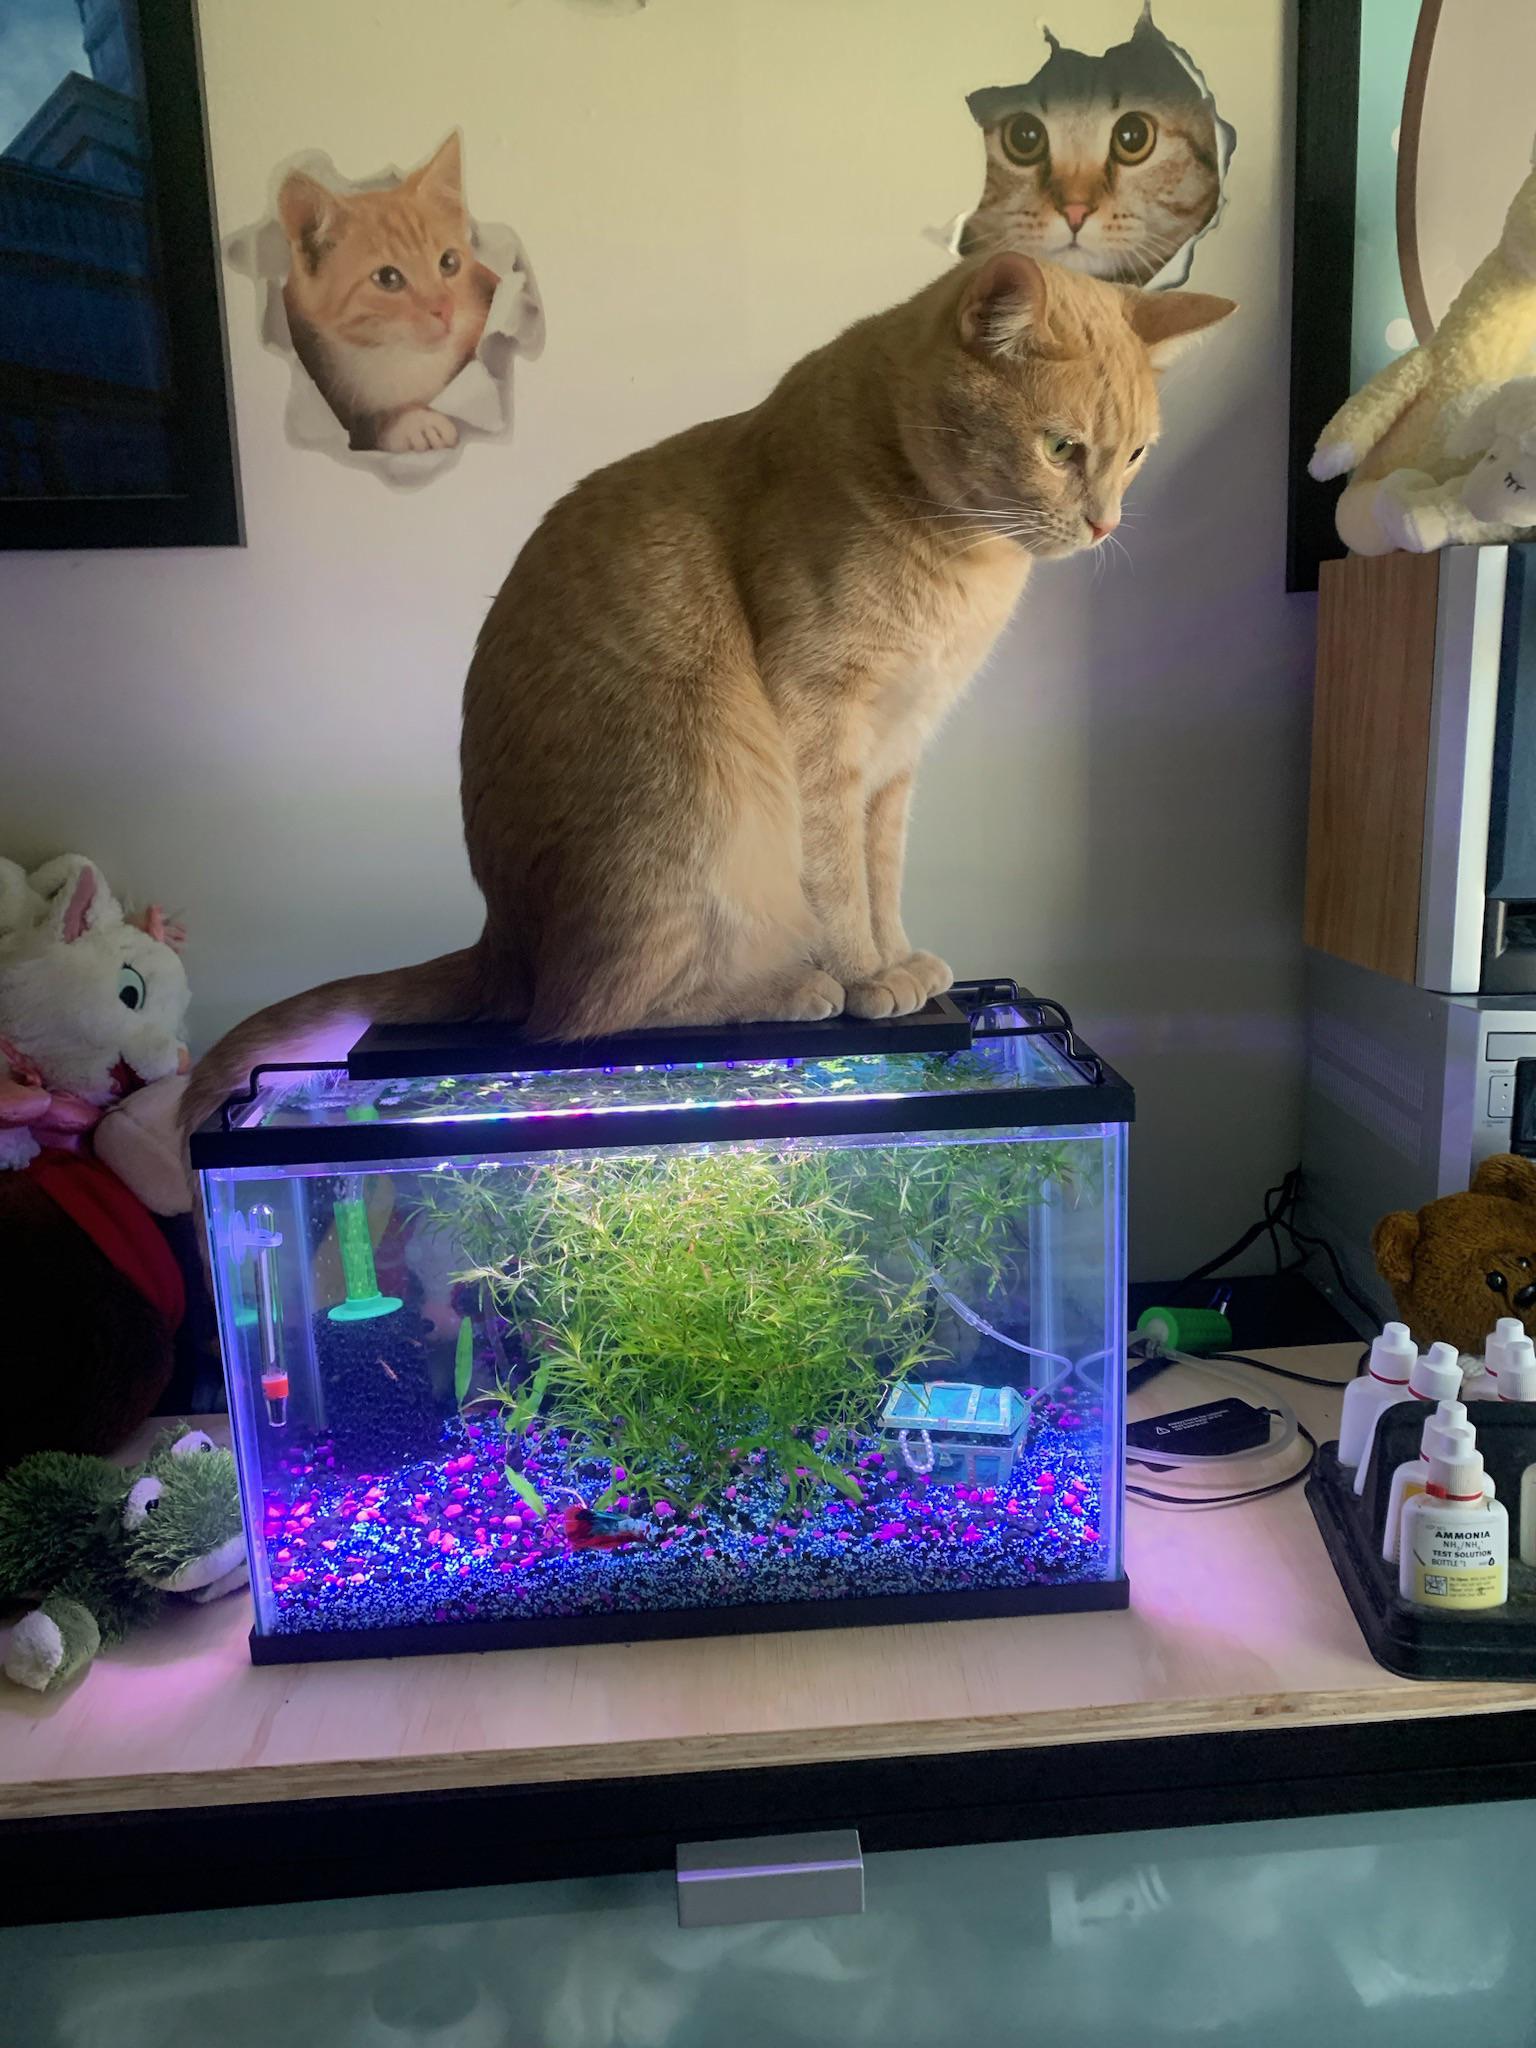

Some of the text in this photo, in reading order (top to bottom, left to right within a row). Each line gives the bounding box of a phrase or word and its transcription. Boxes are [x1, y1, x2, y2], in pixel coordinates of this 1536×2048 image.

[1435, 1531, 1490, 1539] AMMONIA
[1455, 1550, 1492, 1558] SOLUTION
[1432, 1559, 1457, 1567] BOTTLE
